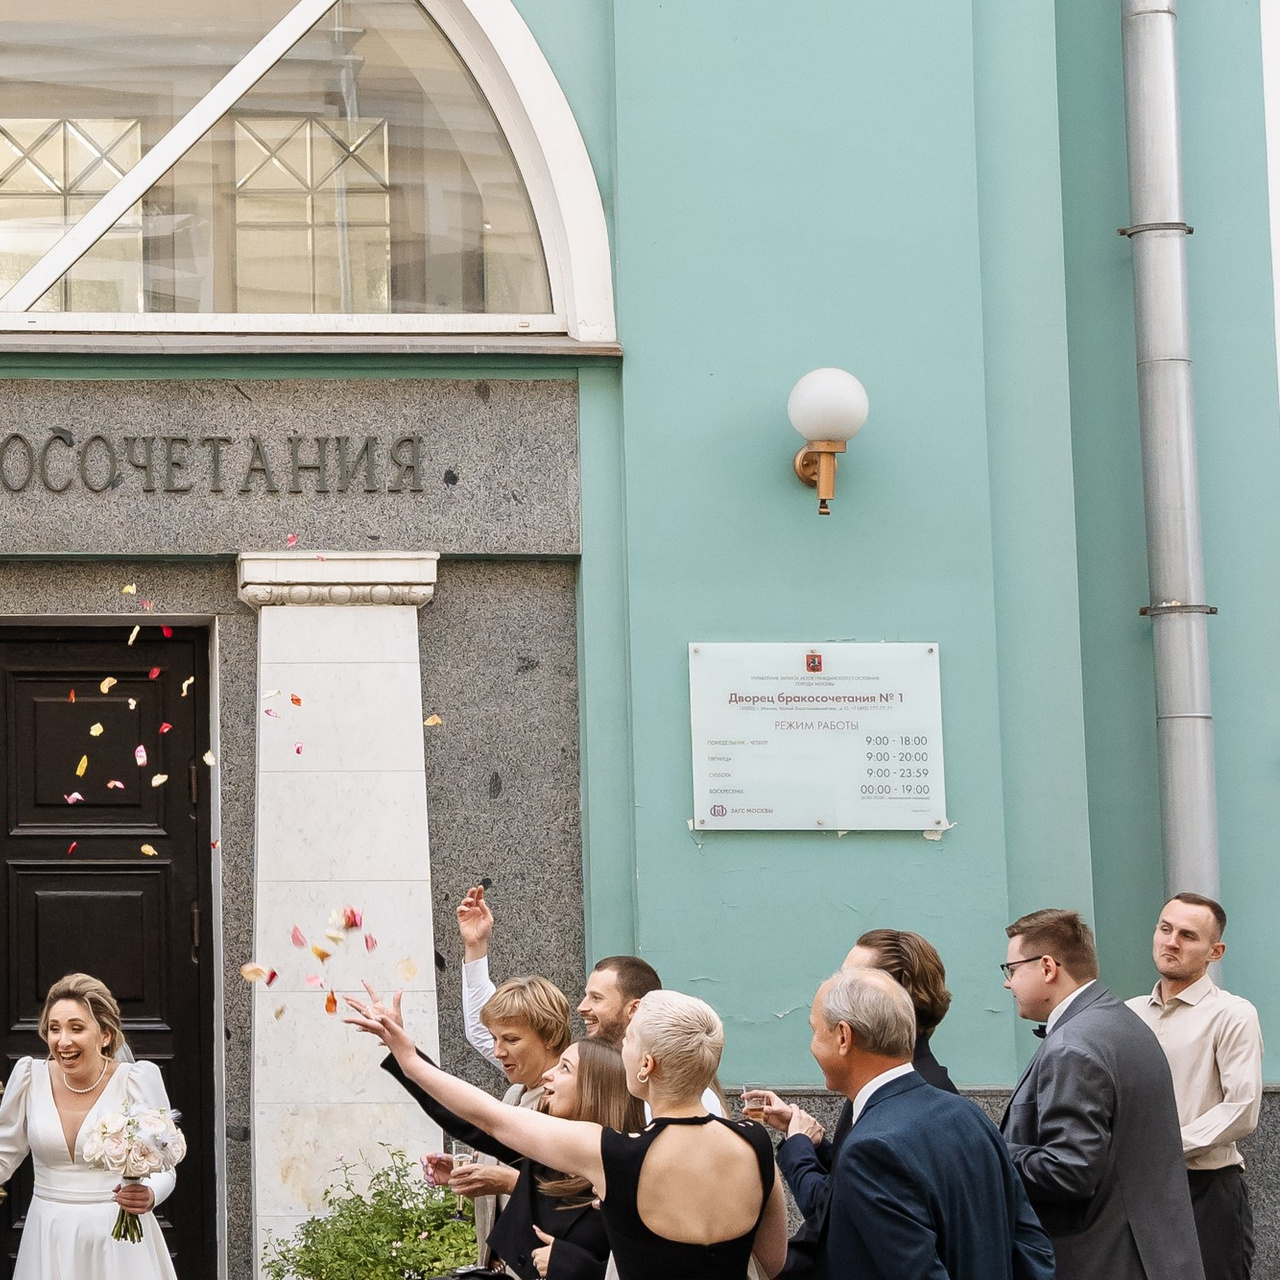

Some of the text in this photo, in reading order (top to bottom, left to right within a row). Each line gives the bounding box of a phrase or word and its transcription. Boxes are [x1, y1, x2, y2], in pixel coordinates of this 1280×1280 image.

[728, 693, 775, 705] Дворец
[777, 692, 876, 705] бракосочетания
[899, 693, 904, 703] 1
[775, 721, 859, 730] РЕЖИМ РАБОТЫ
[865, 736, 889, 745] 9:00
[900, 736, 927, 745] 18:00
[866, 752, 889, 761] 9:00
[899, 752, 928, 761] 20:00
[867, 768, 890, 777] 9:00
[900, 768, 929, 777] 23:59
[860, 785, 891, 794] 00:00
[901, 785, 930, 794] 19:00
